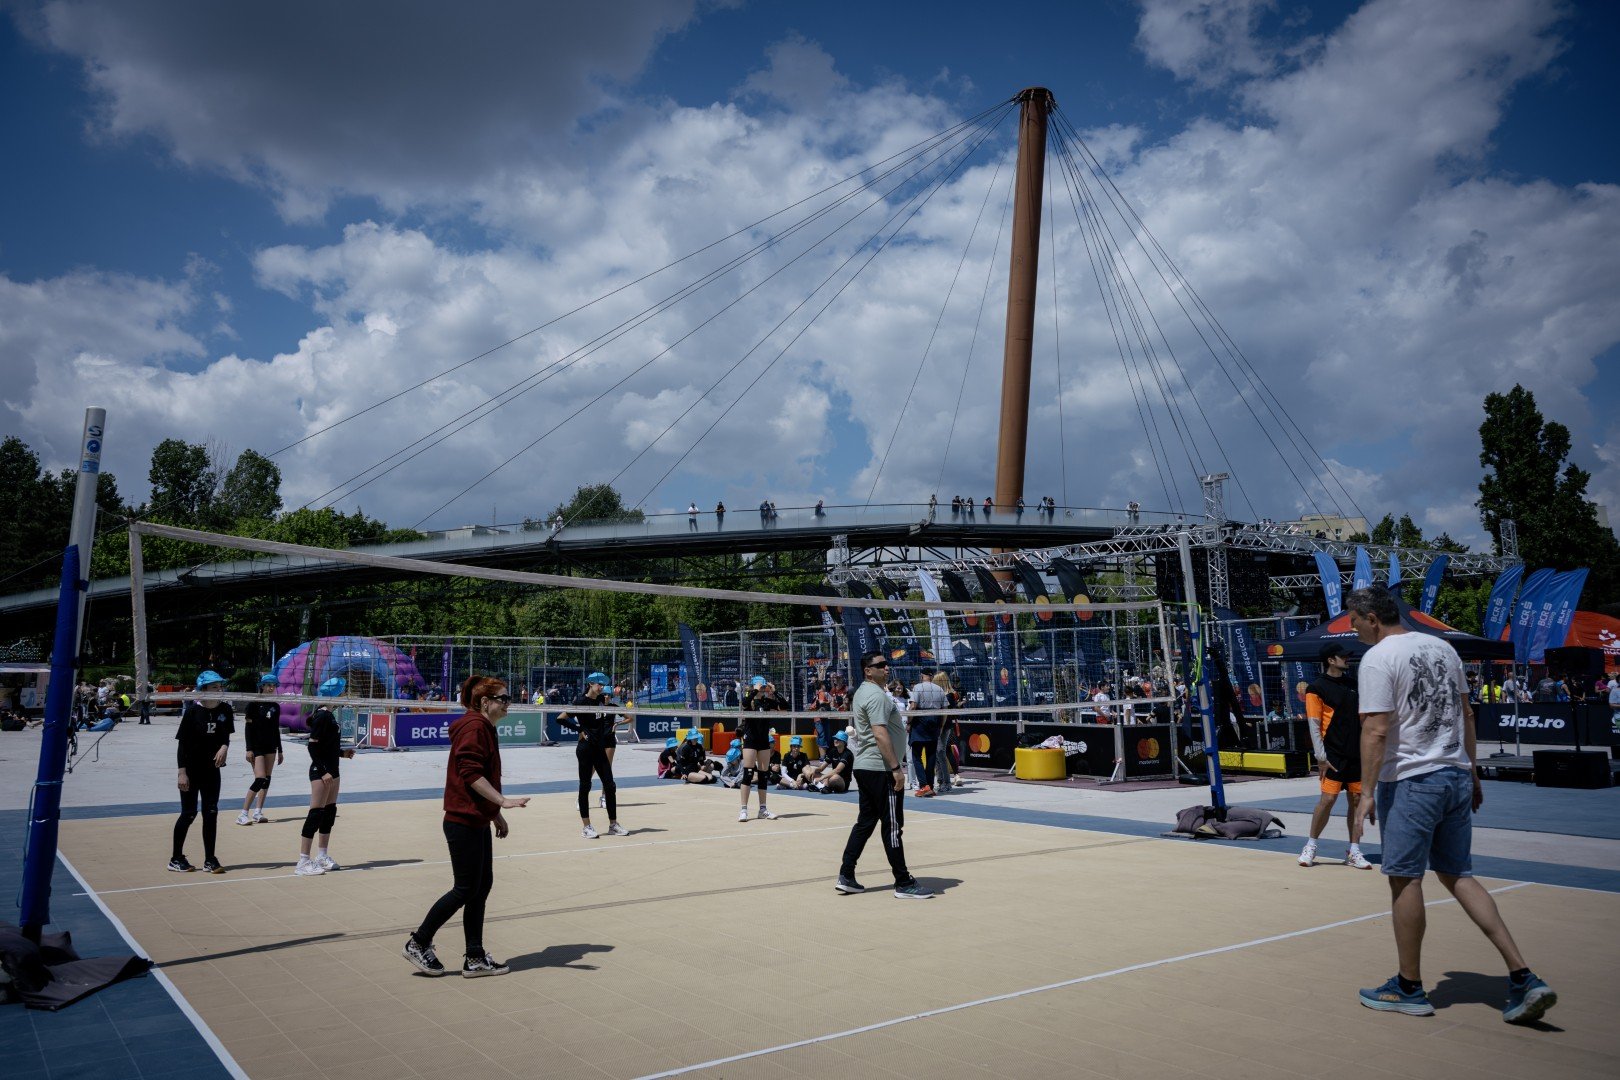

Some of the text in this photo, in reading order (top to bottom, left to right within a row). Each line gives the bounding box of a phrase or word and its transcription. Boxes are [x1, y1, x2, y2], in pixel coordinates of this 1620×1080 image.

[1491, 606, 1502, 623] BCR
[1537, 610, 1549, 627] BCR
[648, 721, 670, 733] BCR
[1498, 714, 1566, 729] 3la3.ro
[206, 722, 217, 734] 12
[411, 727, 437, 739] BCR
[497, 725, 513, 737] CR
